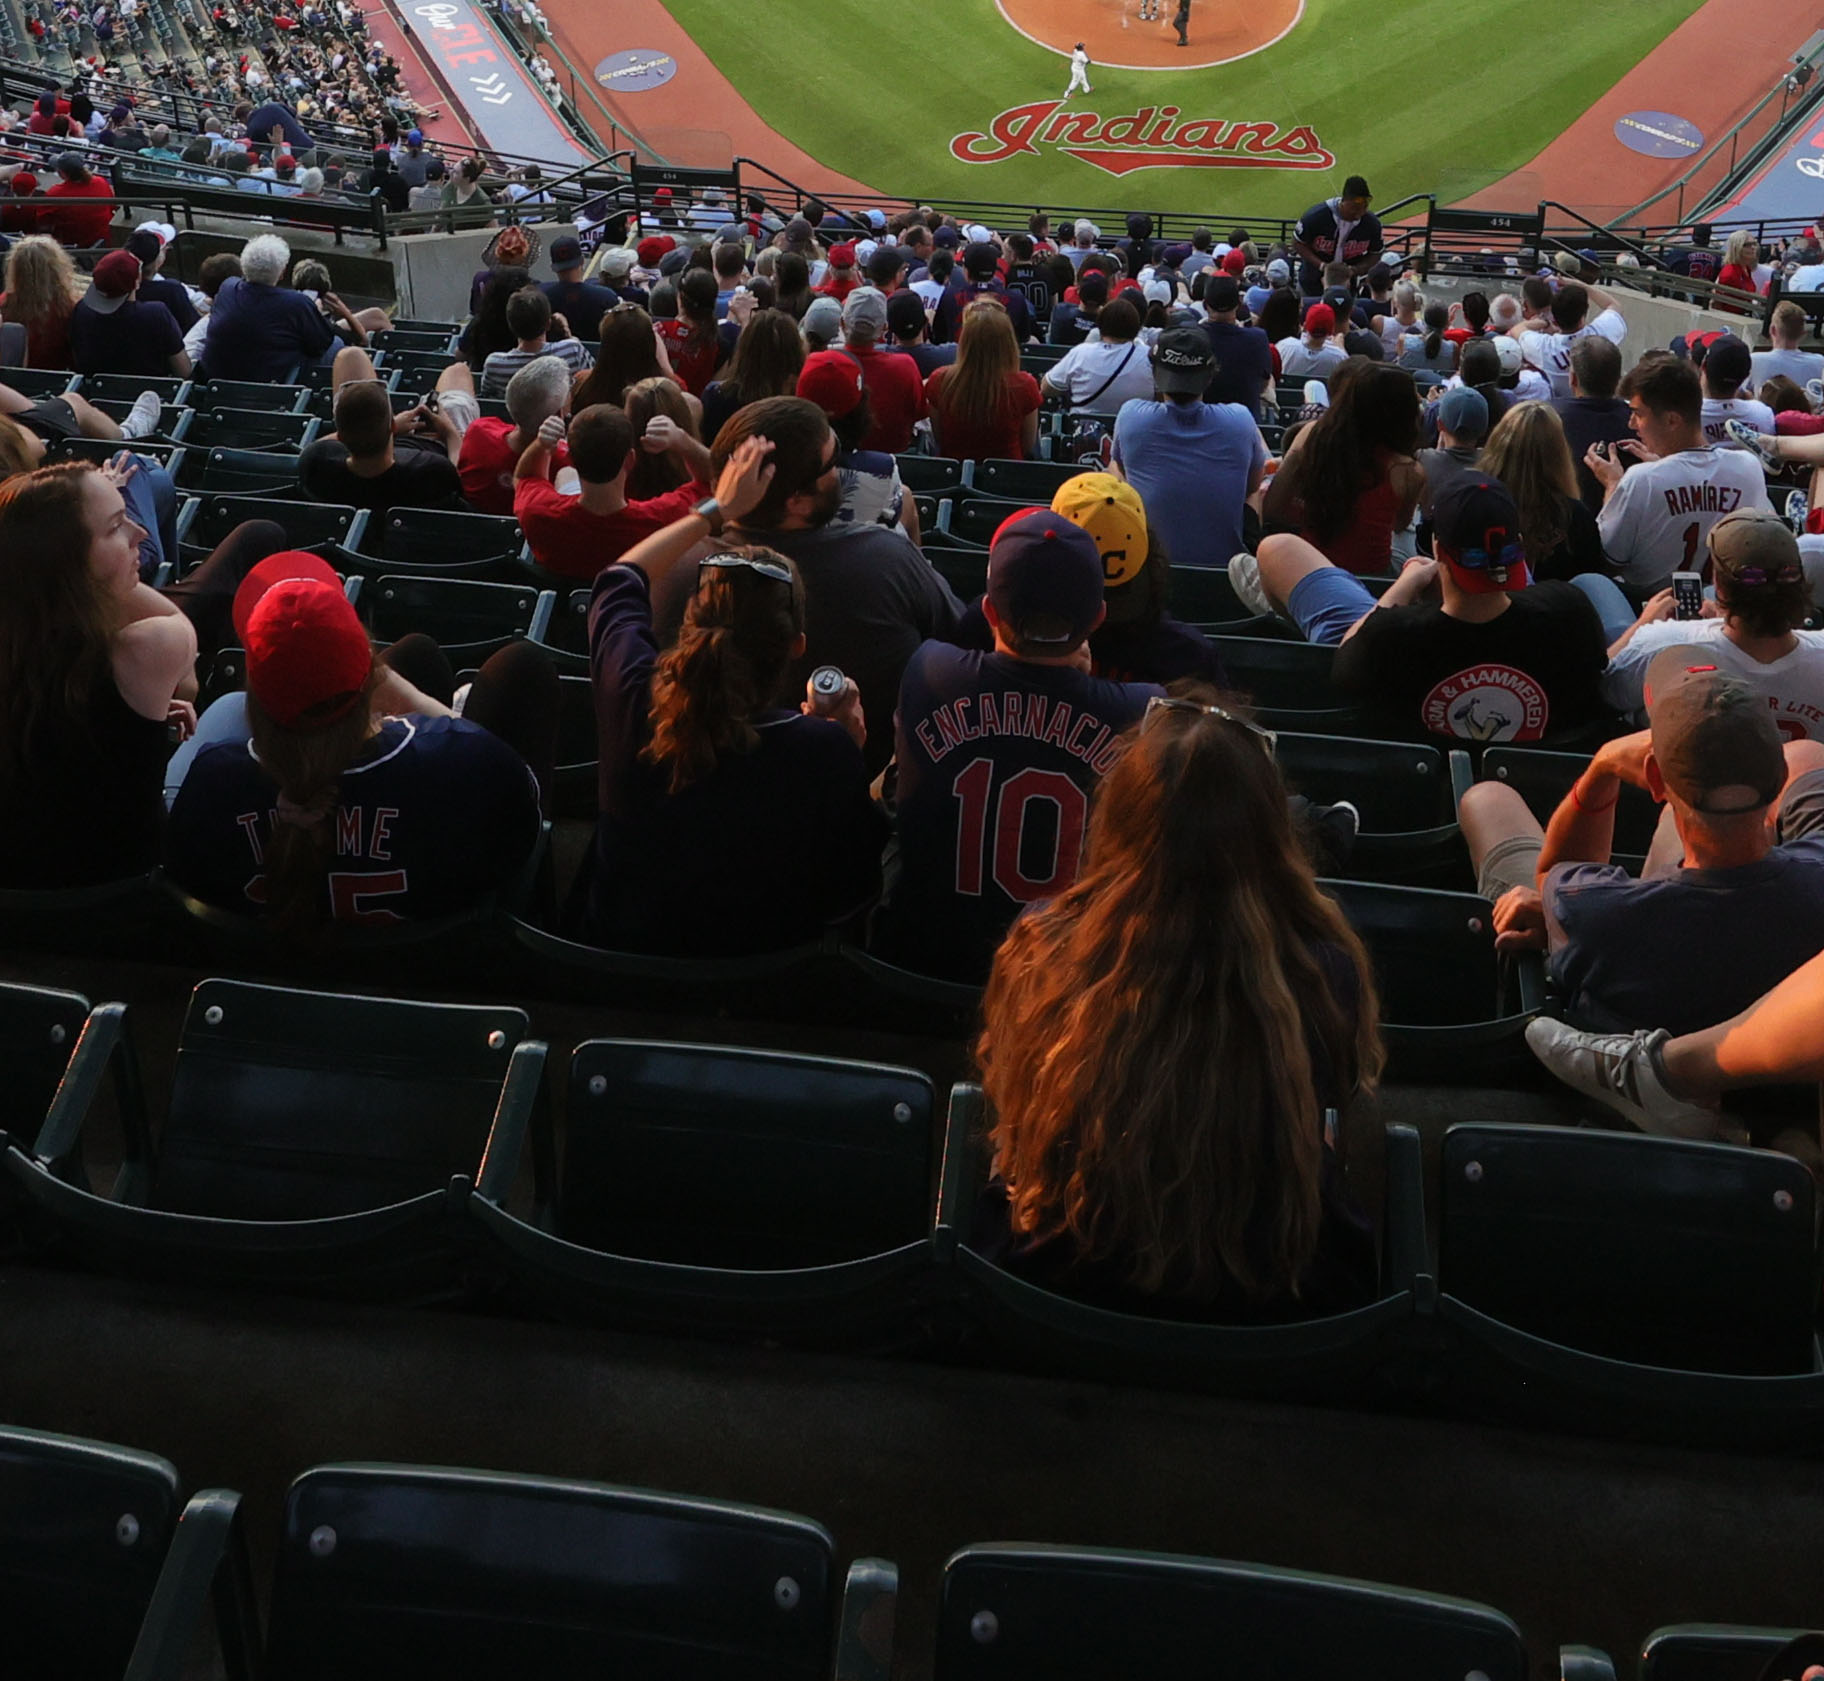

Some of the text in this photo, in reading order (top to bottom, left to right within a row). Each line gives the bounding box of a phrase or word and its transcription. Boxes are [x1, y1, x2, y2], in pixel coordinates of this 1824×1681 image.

[949, 98, 1336, 178] Indians
[1162, 348, 1204, 367] Titleist
[1663, 479, 1743, 516] RAMÍREZ
[1101, 549, 1126, 580] C
[1441, 669, 1542, 728] & HAMMERED
[1787, 702, 1824, 723] LITE
[236, 806, 400, 864] TME
[952, 757, 1087, 903] 10
